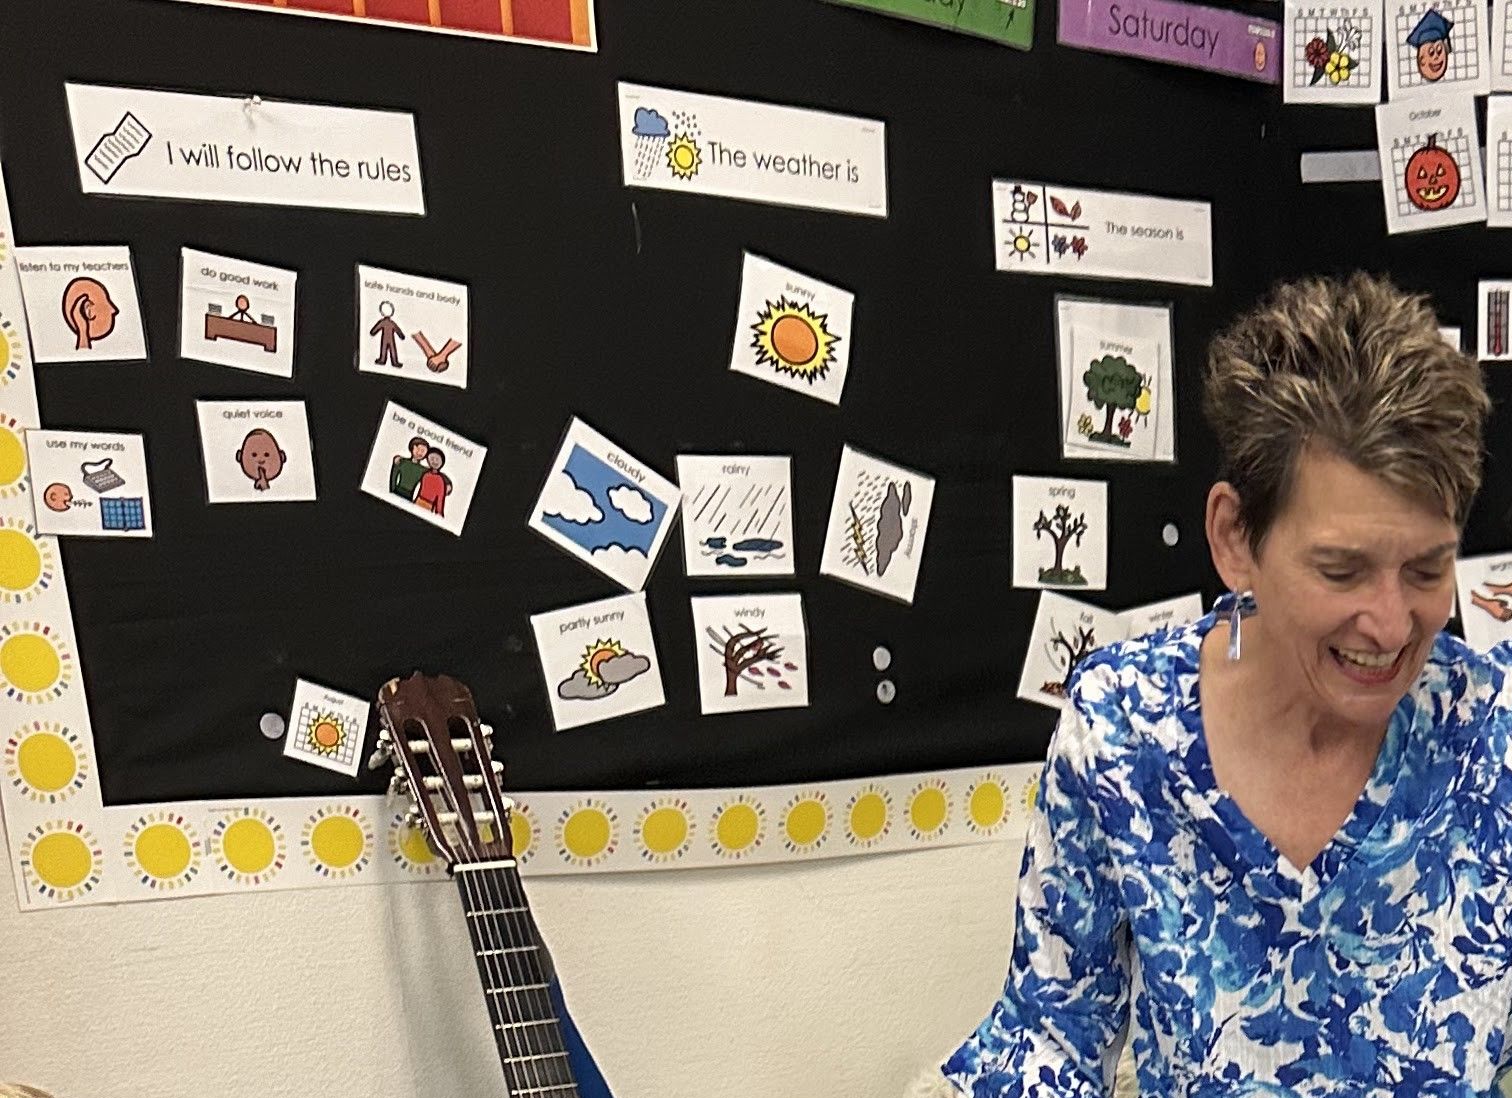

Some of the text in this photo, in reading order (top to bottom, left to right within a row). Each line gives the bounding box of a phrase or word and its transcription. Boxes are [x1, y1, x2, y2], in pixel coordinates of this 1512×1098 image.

[1109, 3, 1220, 58] Saturday
[167, 141, 411, 183] I will follow the rules
[707, 140, 859, 183] The weather is
[1105, 220, 1184, 241] The season is
[20, 261, 129, 273] listen to my teachers
[201, 267, 279, 291] do good work
[386, 284, 414, 297] hands
[416, 290, 435, 300] and
[437, 293, 460, 306] body
[786, 282, 815, 301] sunny
[1100, 340, 1133, 355] summer
[222, 409, 283, 420] quiet voice
[392, 411, 407, 424] be
[416, 425, 445, 443] good
[445, 438, 474, 458] friend
[46, 440, 125, 452] use my words
[607, 451, 646, 483] cloudy
[722, 462, 751, 476] rainy
[1049, 485, 1076, 500] spring
[559, 609, 625, 635] partly sunny
[734, 607, 766, 619] windy
[1080, 611, 1094, 624] fall
[1150, 610, 1174, 622] winter
